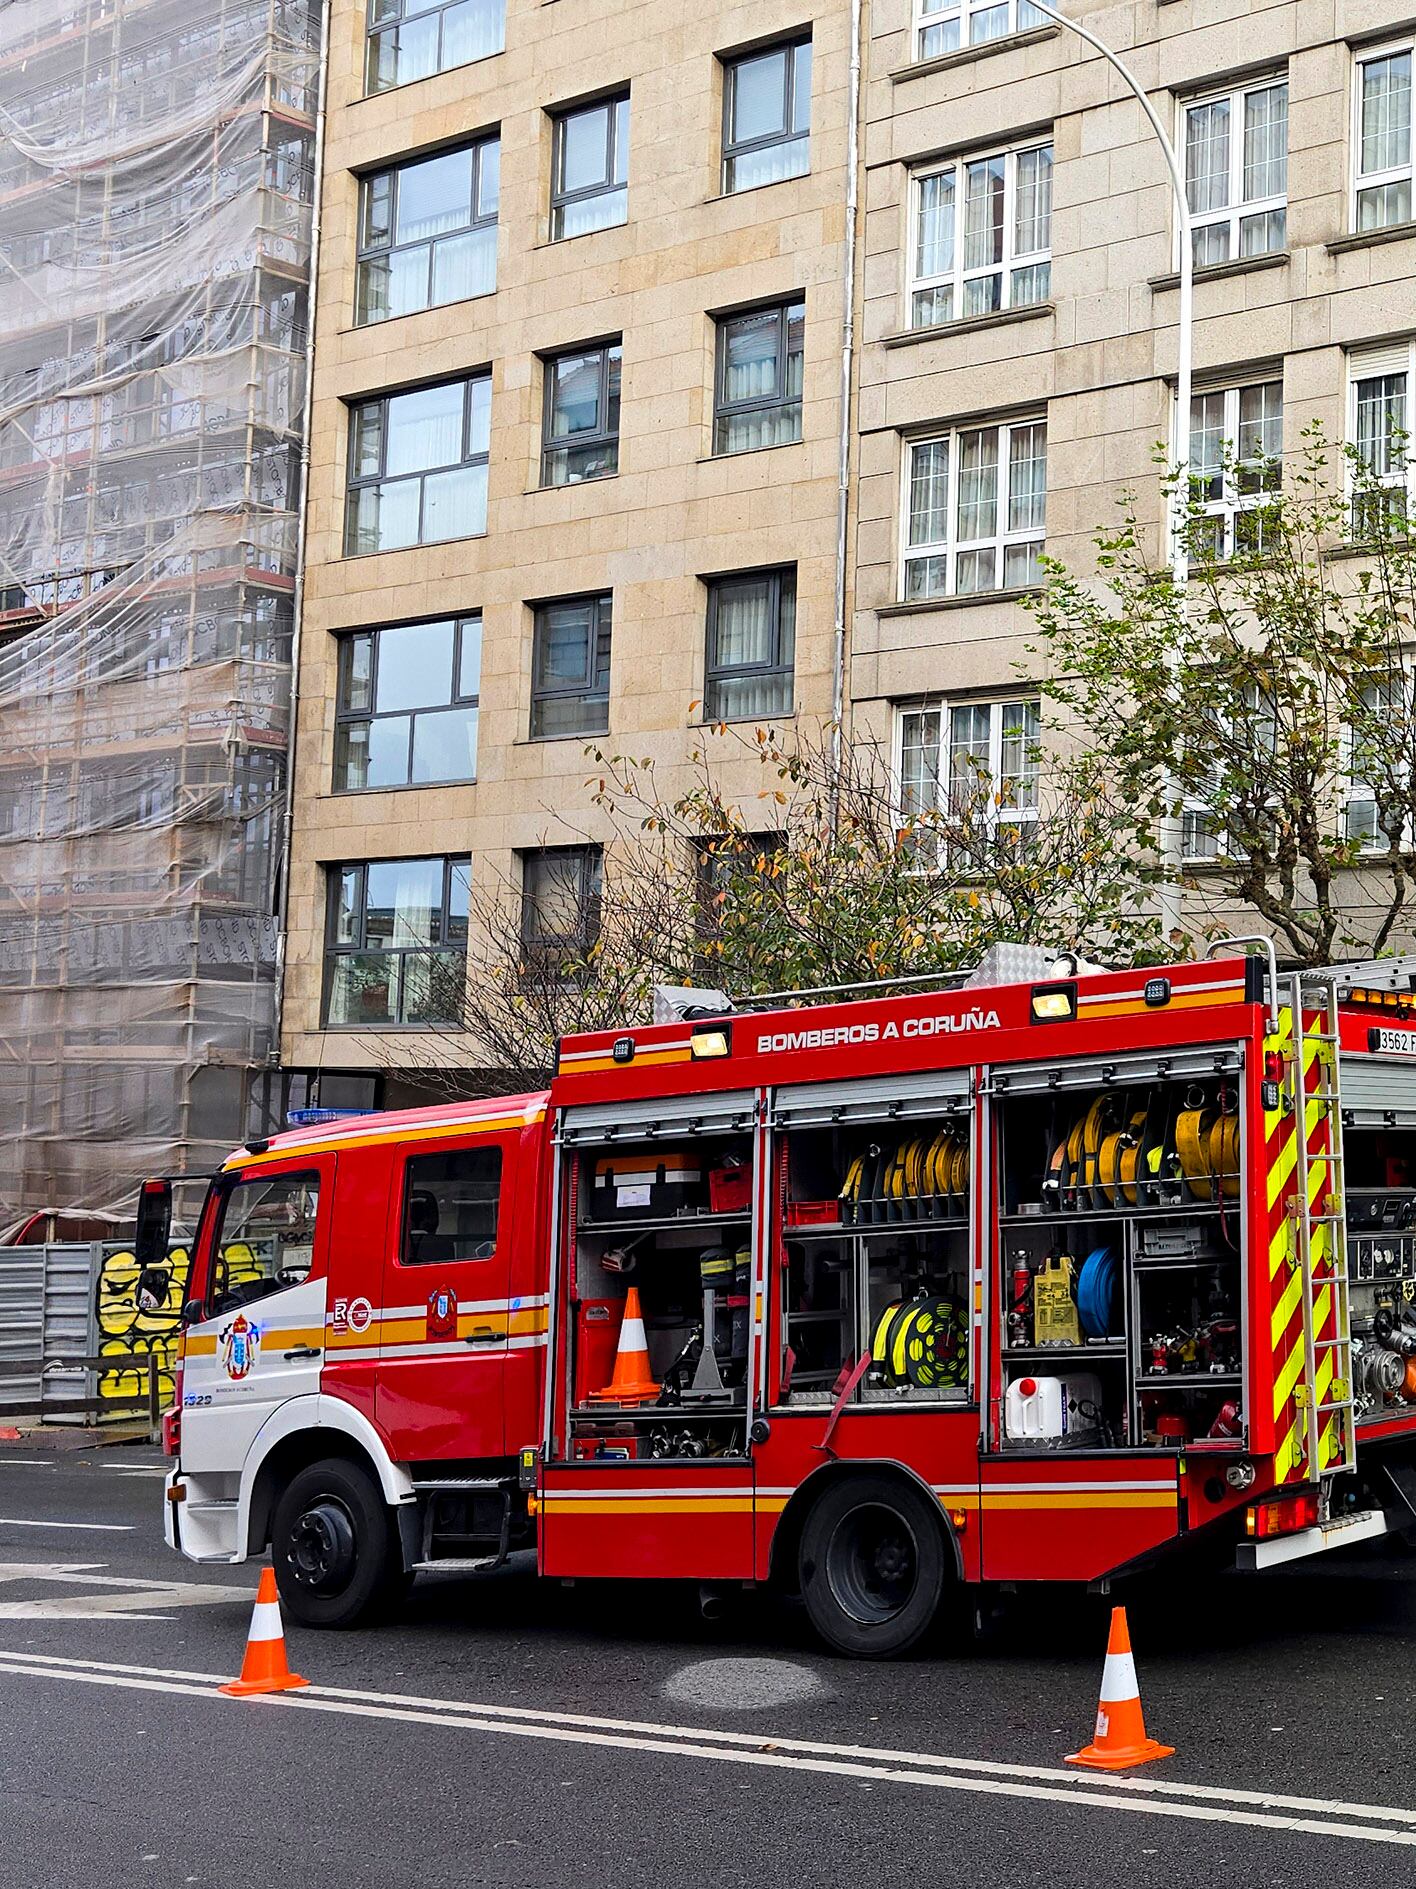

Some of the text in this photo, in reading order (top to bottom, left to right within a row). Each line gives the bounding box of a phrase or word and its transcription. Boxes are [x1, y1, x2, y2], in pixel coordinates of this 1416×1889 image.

[757, 1007, 1001, 1053] BOMBEROS A CORUÑA
[1381, 1031, 1408, 1051] 3562
